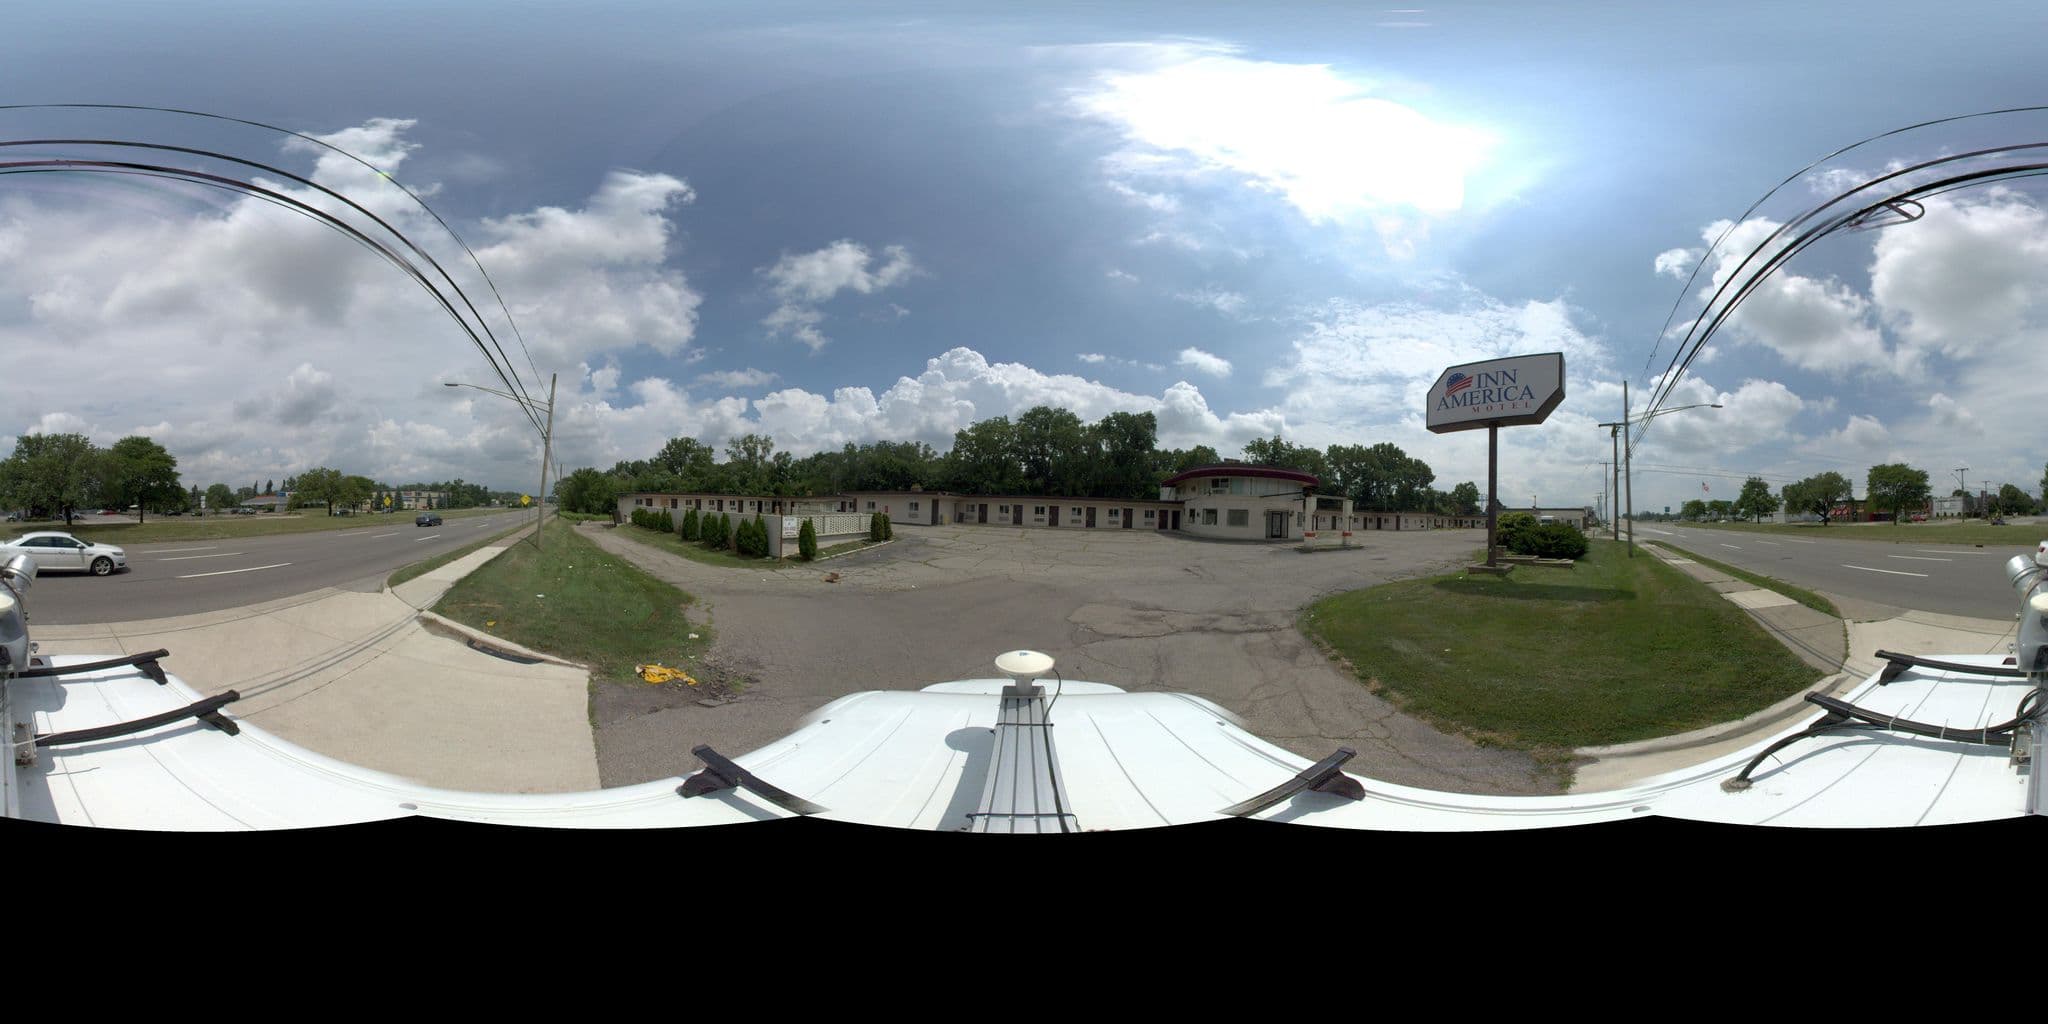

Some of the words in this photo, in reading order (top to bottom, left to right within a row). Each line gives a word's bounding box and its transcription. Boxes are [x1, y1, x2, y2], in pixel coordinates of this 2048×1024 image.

[1476, 368, 1517, 389] INN
[1437, 384, 1536, 412] AMERICA
[1471, 401, 1532, 414] MOTEL
